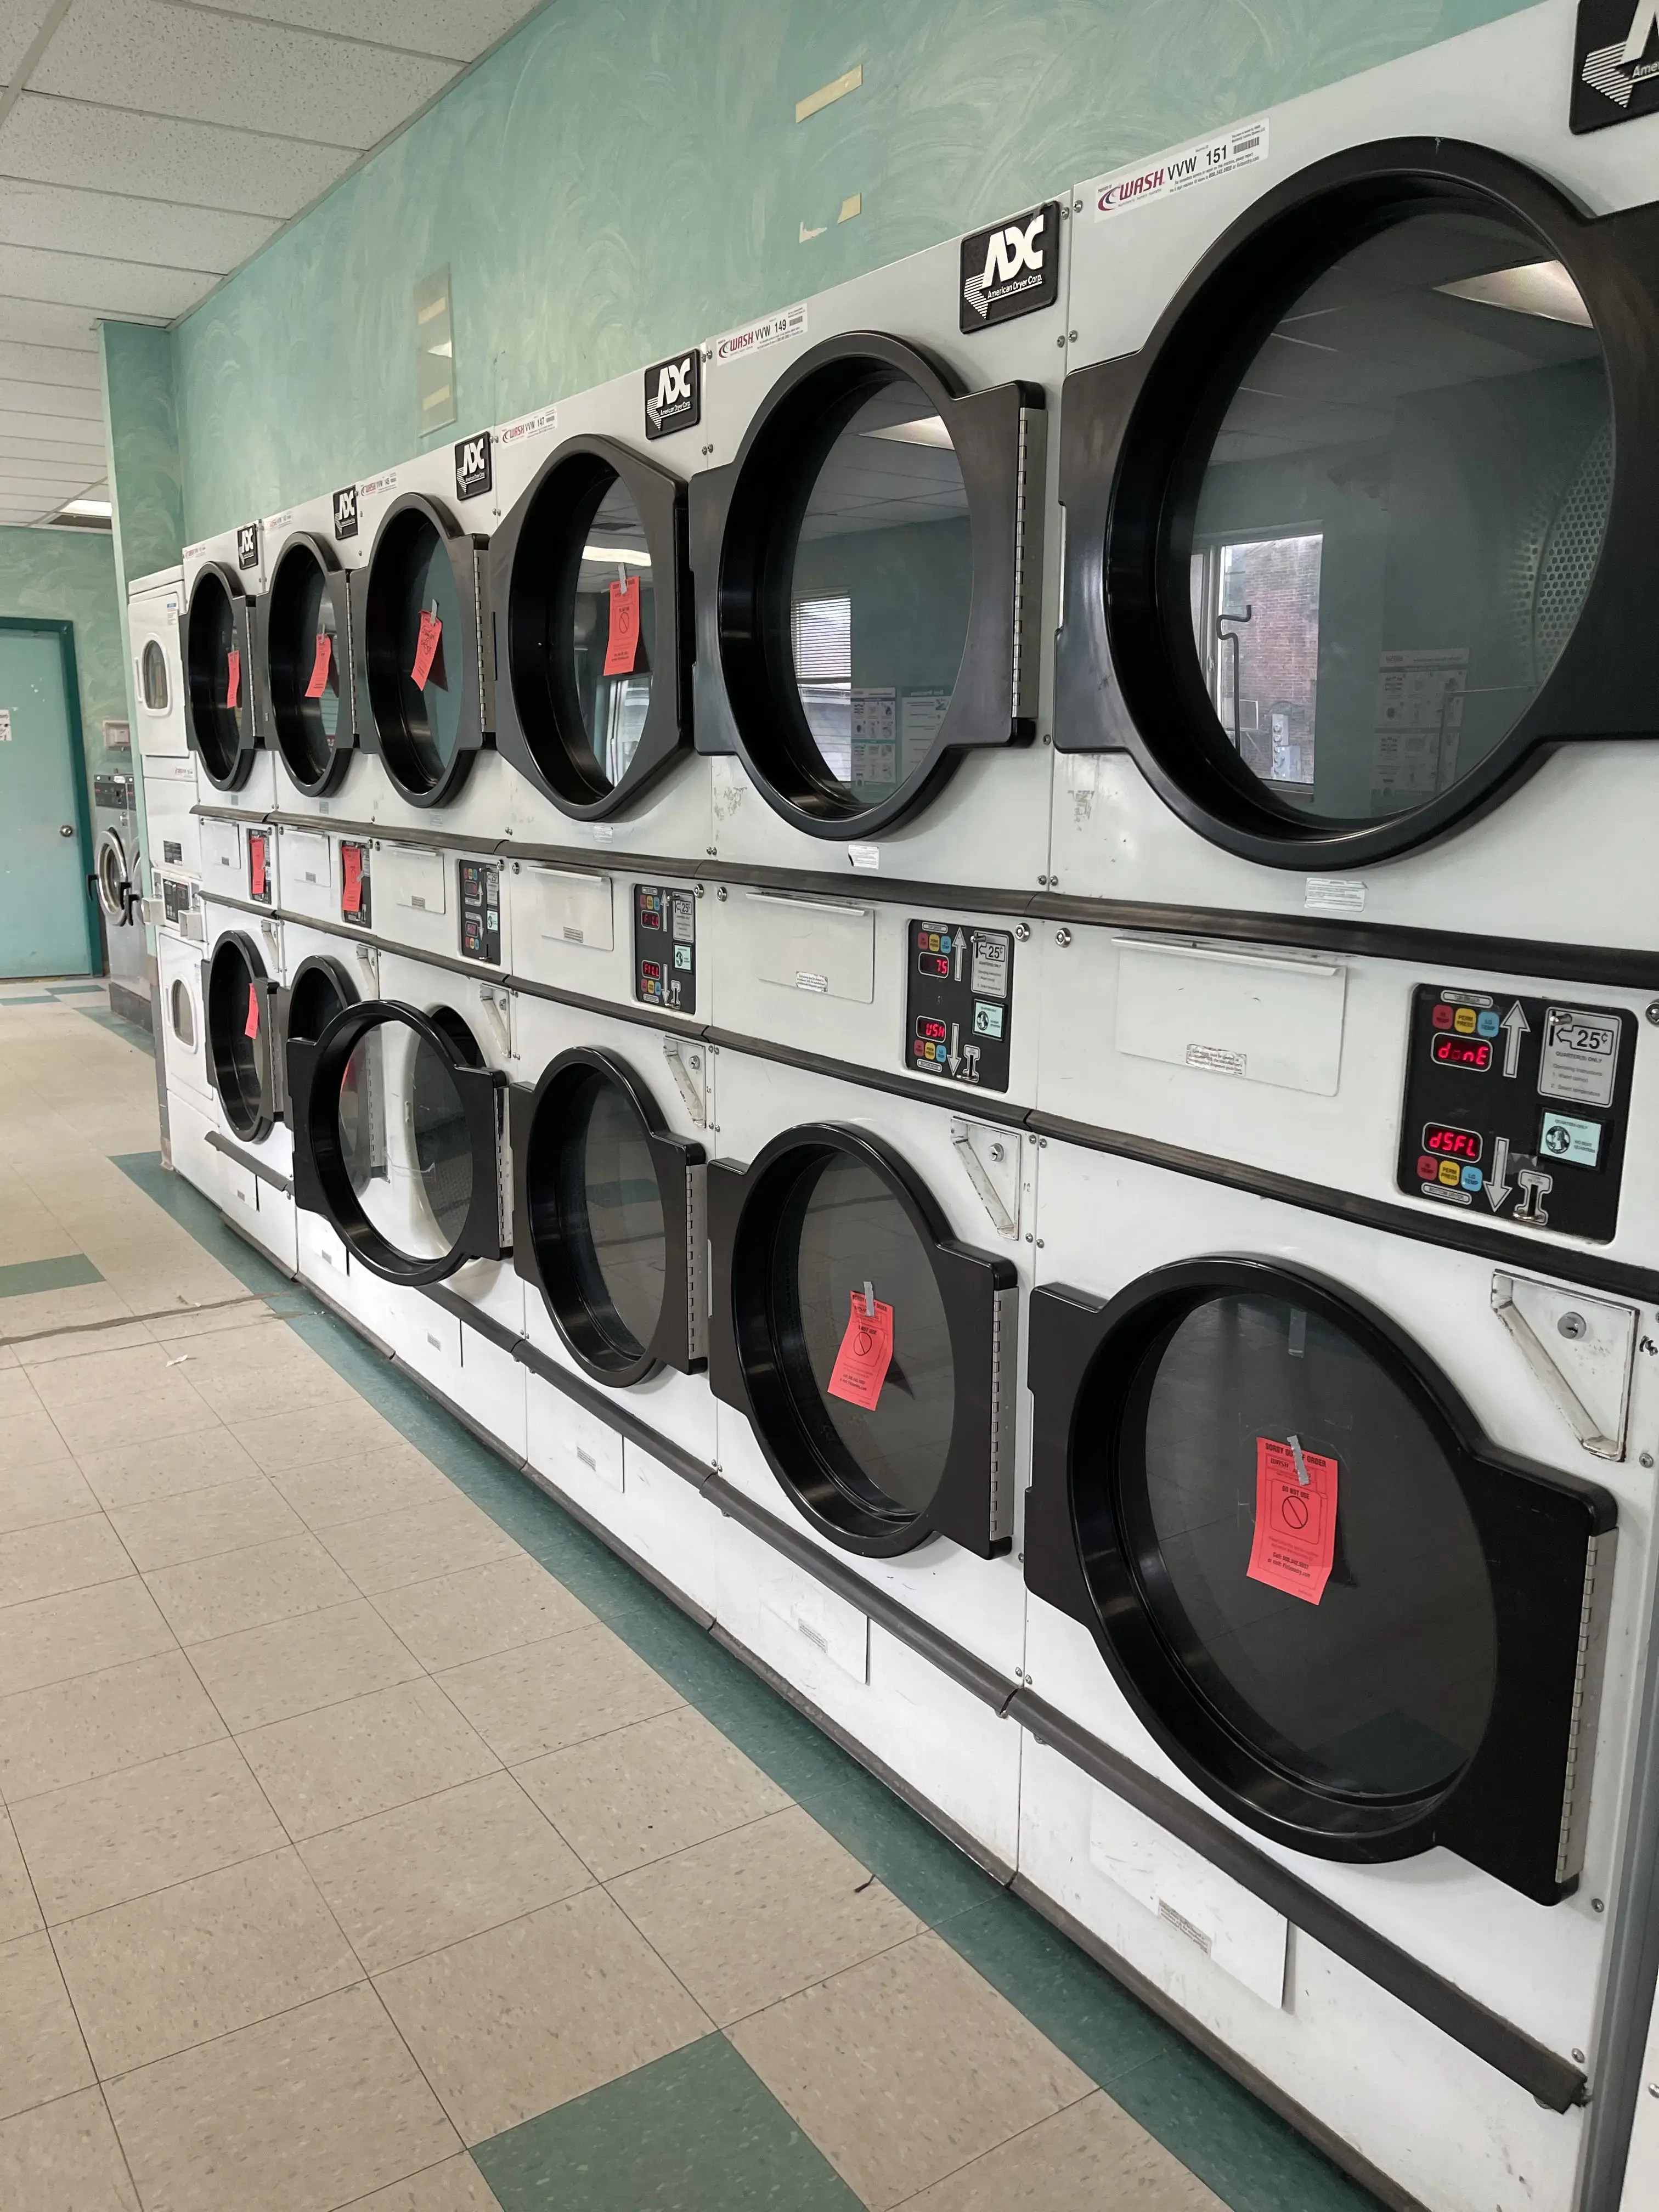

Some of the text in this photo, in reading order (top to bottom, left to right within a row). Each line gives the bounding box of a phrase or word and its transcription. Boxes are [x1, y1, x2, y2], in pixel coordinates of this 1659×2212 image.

[1119, 145, 1227, 201] WASH VVW 151
[982, 214, 1044, 288] ADC
[988, 274, 1042, 298] American Dryer Corp.
[730, 331, 754, 351] WASH
[755, 325, 770, 341] VVW
[775, 319, 786, 332] 149
[658, 358, 691, 407] ADC
[661, 407, 674, 415] American
[464, 438, 485, 476] ADC
[339, 490, 355, 520] ADC
[1577, 1030, 1608, 1049] 25¢
[1266, 1443, 1283, 1455] SORRY
[1307, 1455, 1327, 1468] ORDER
